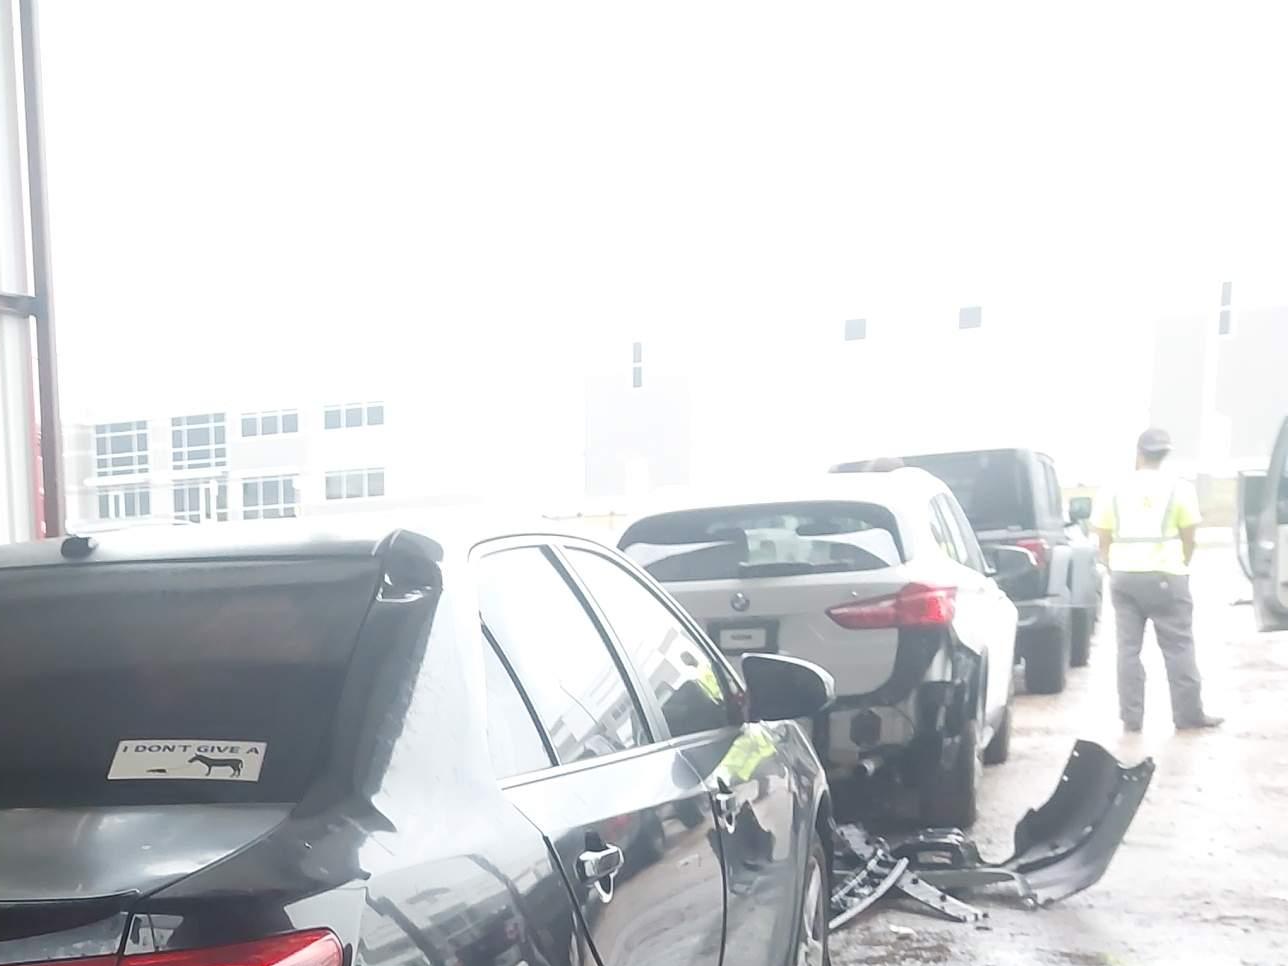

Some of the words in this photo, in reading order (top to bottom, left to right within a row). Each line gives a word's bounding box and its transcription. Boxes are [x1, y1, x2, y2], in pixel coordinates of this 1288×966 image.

[122, 745, 128, 753] I
[134, 744, 192, 753] DON'T
[197, 745, 241, 754] GIVE
[246, 746, 260, 754] A
